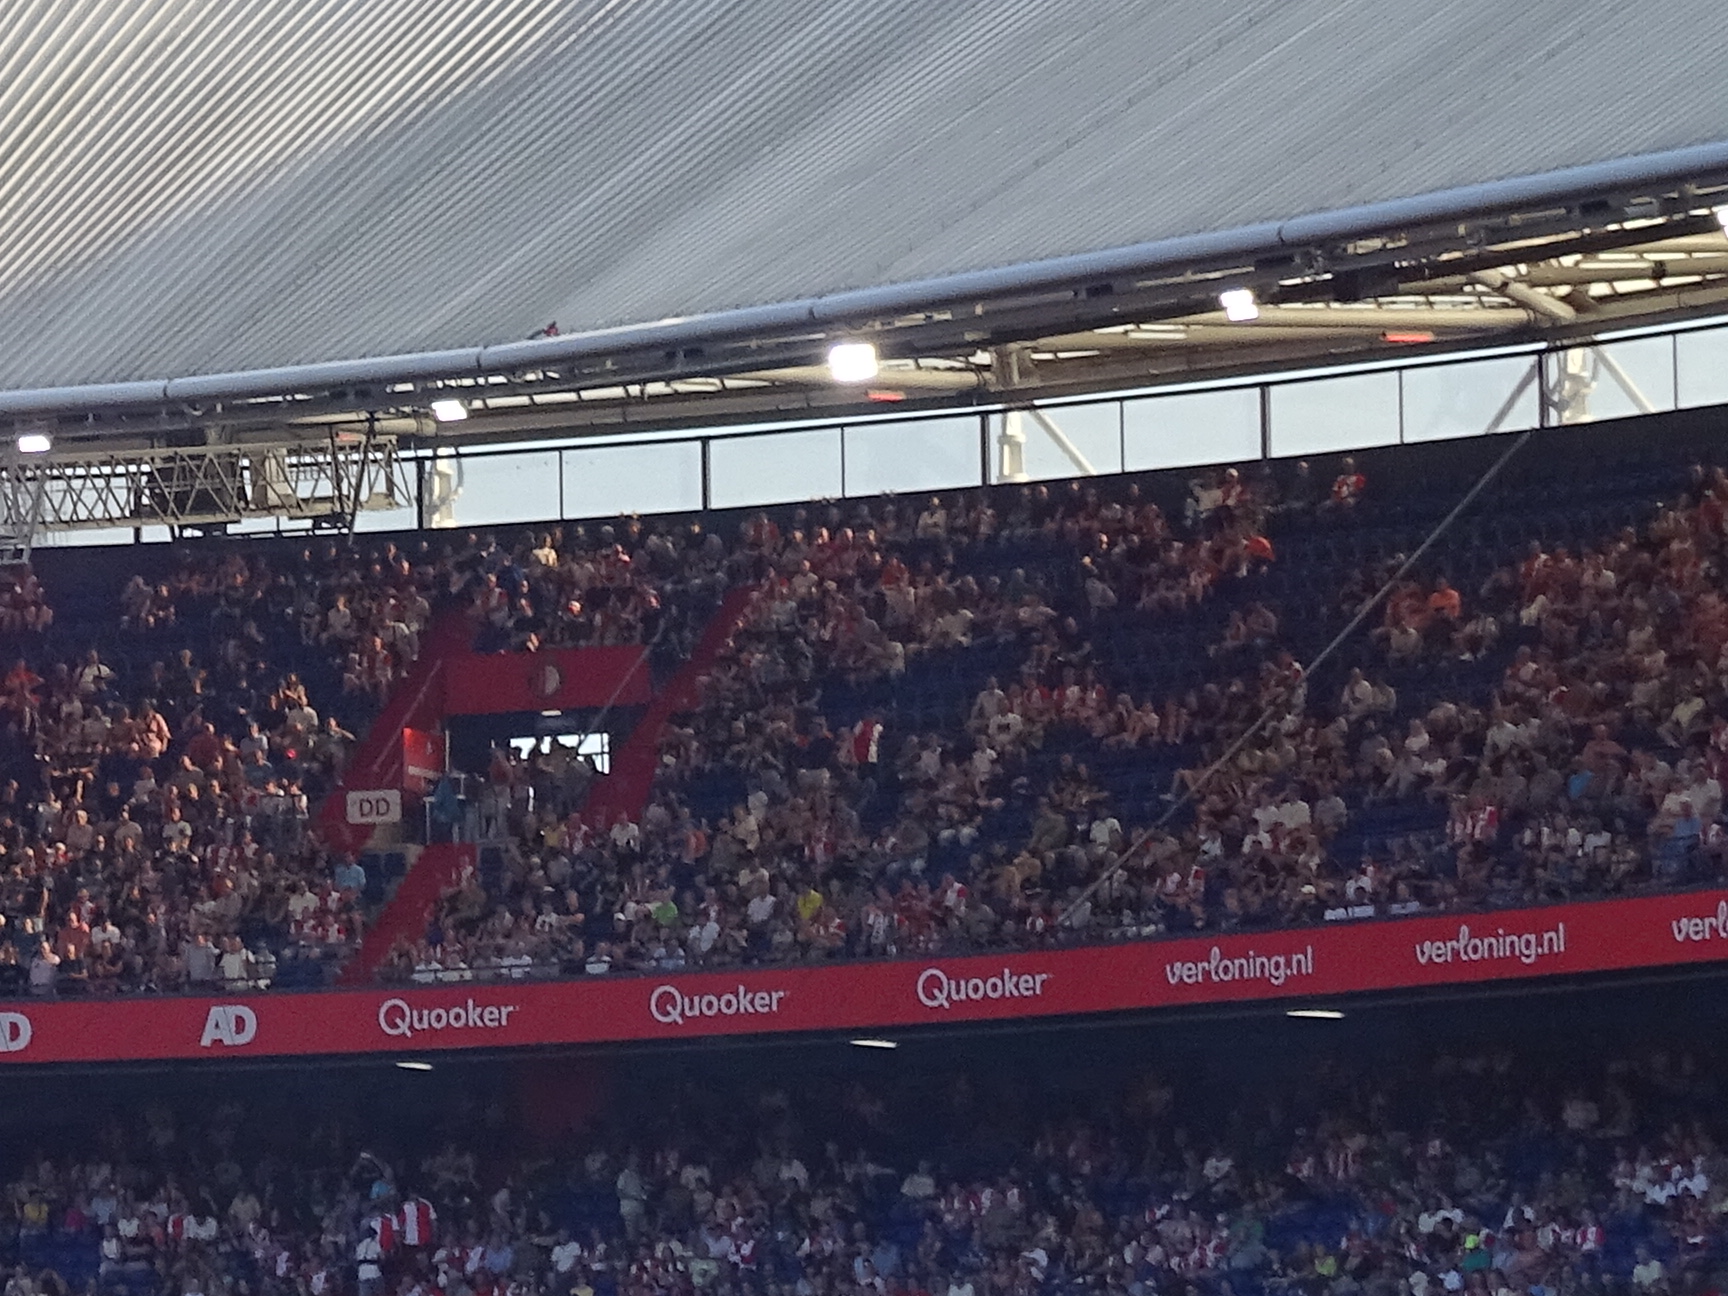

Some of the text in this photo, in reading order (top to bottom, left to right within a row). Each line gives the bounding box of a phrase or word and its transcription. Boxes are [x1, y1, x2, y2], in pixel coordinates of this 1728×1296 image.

[359, 798, 390, 817] DD
[1671, 900, 1728, 942] verl
[1415, 922, 1565, 965] verloning.nl
[1165, 945, 1313, 986] verloning.nl
[650, 984, 786, 1025] Quooker
[916, 967, 1050, 1009] Quooker
[200, 1004, 258, 1047] AD
[378, 998, 515, 1038] Quooker
